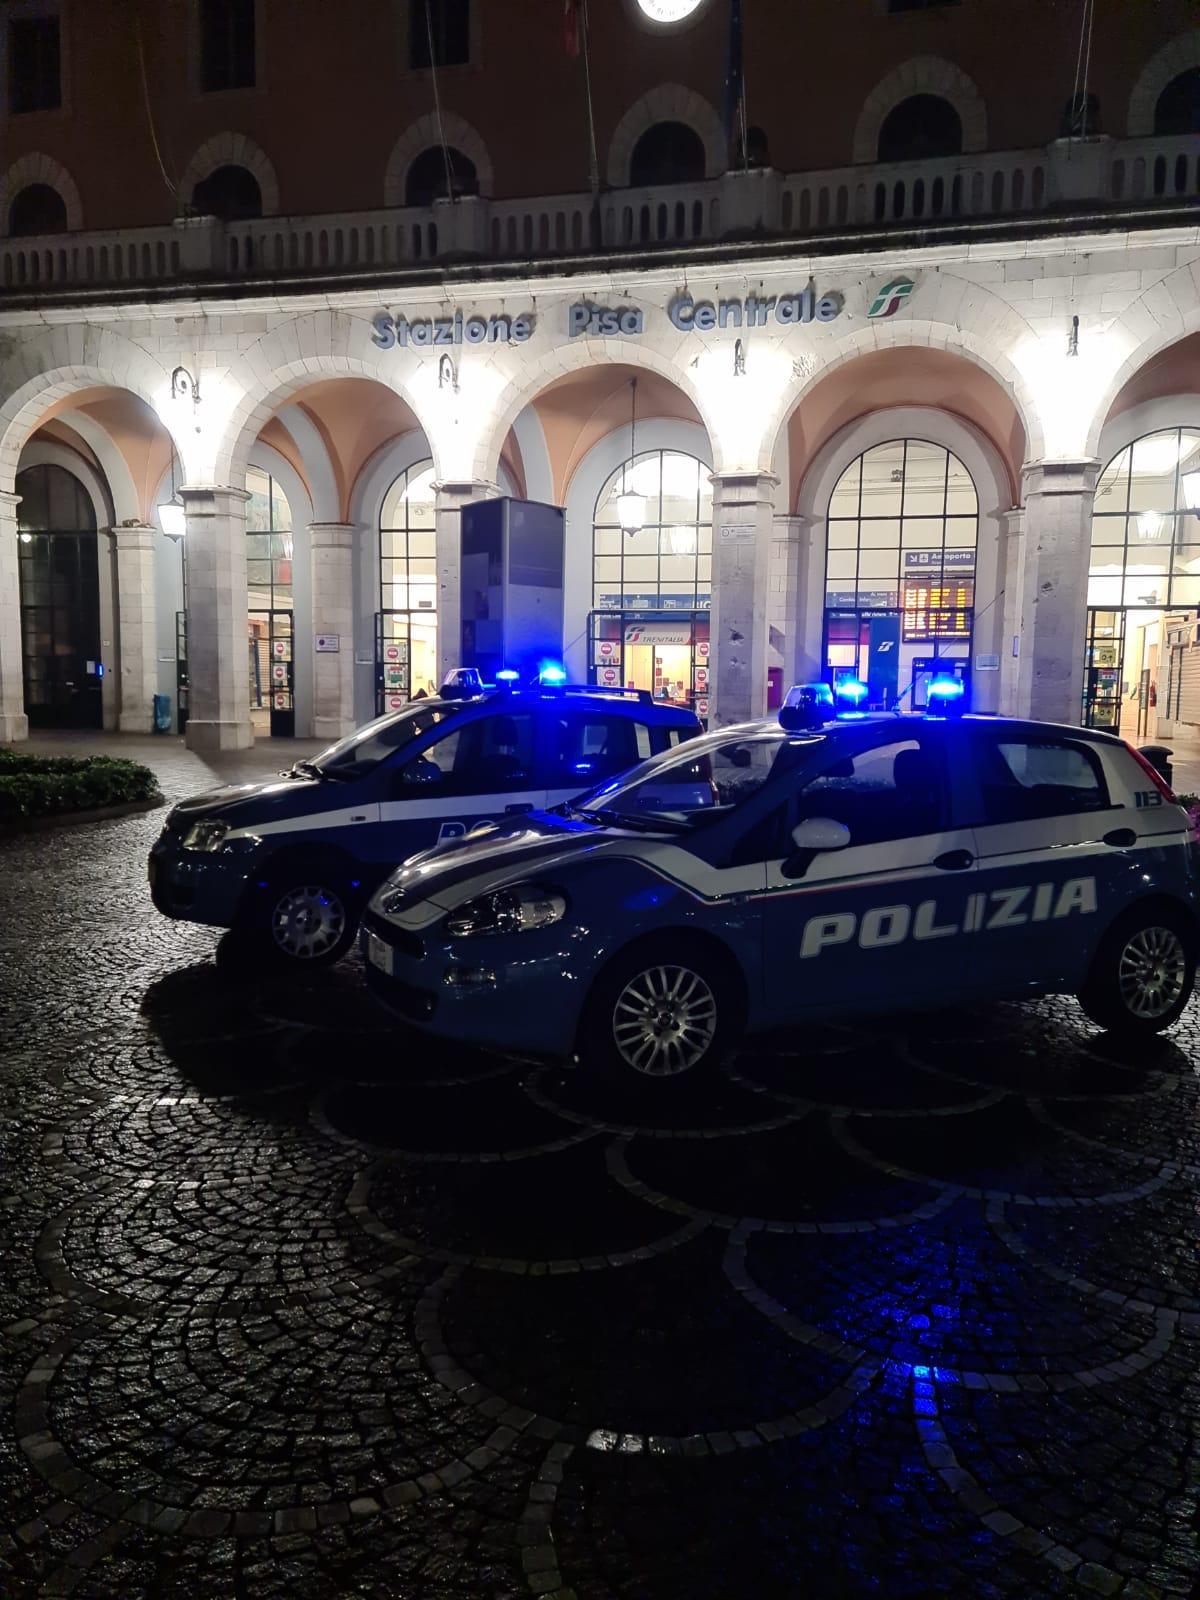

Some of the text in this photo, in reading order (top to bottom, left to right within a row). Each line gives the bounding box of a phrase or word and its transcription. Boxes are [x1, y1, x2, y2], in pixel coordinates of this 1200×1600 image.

[372, 288, 841, 349] Stazione Pisa Centrale
[931, 553, 971, 561] Aeoporto
[1134, 791, 1162, 808] 113
[800, 876, 1097, 958] POLIZIA
